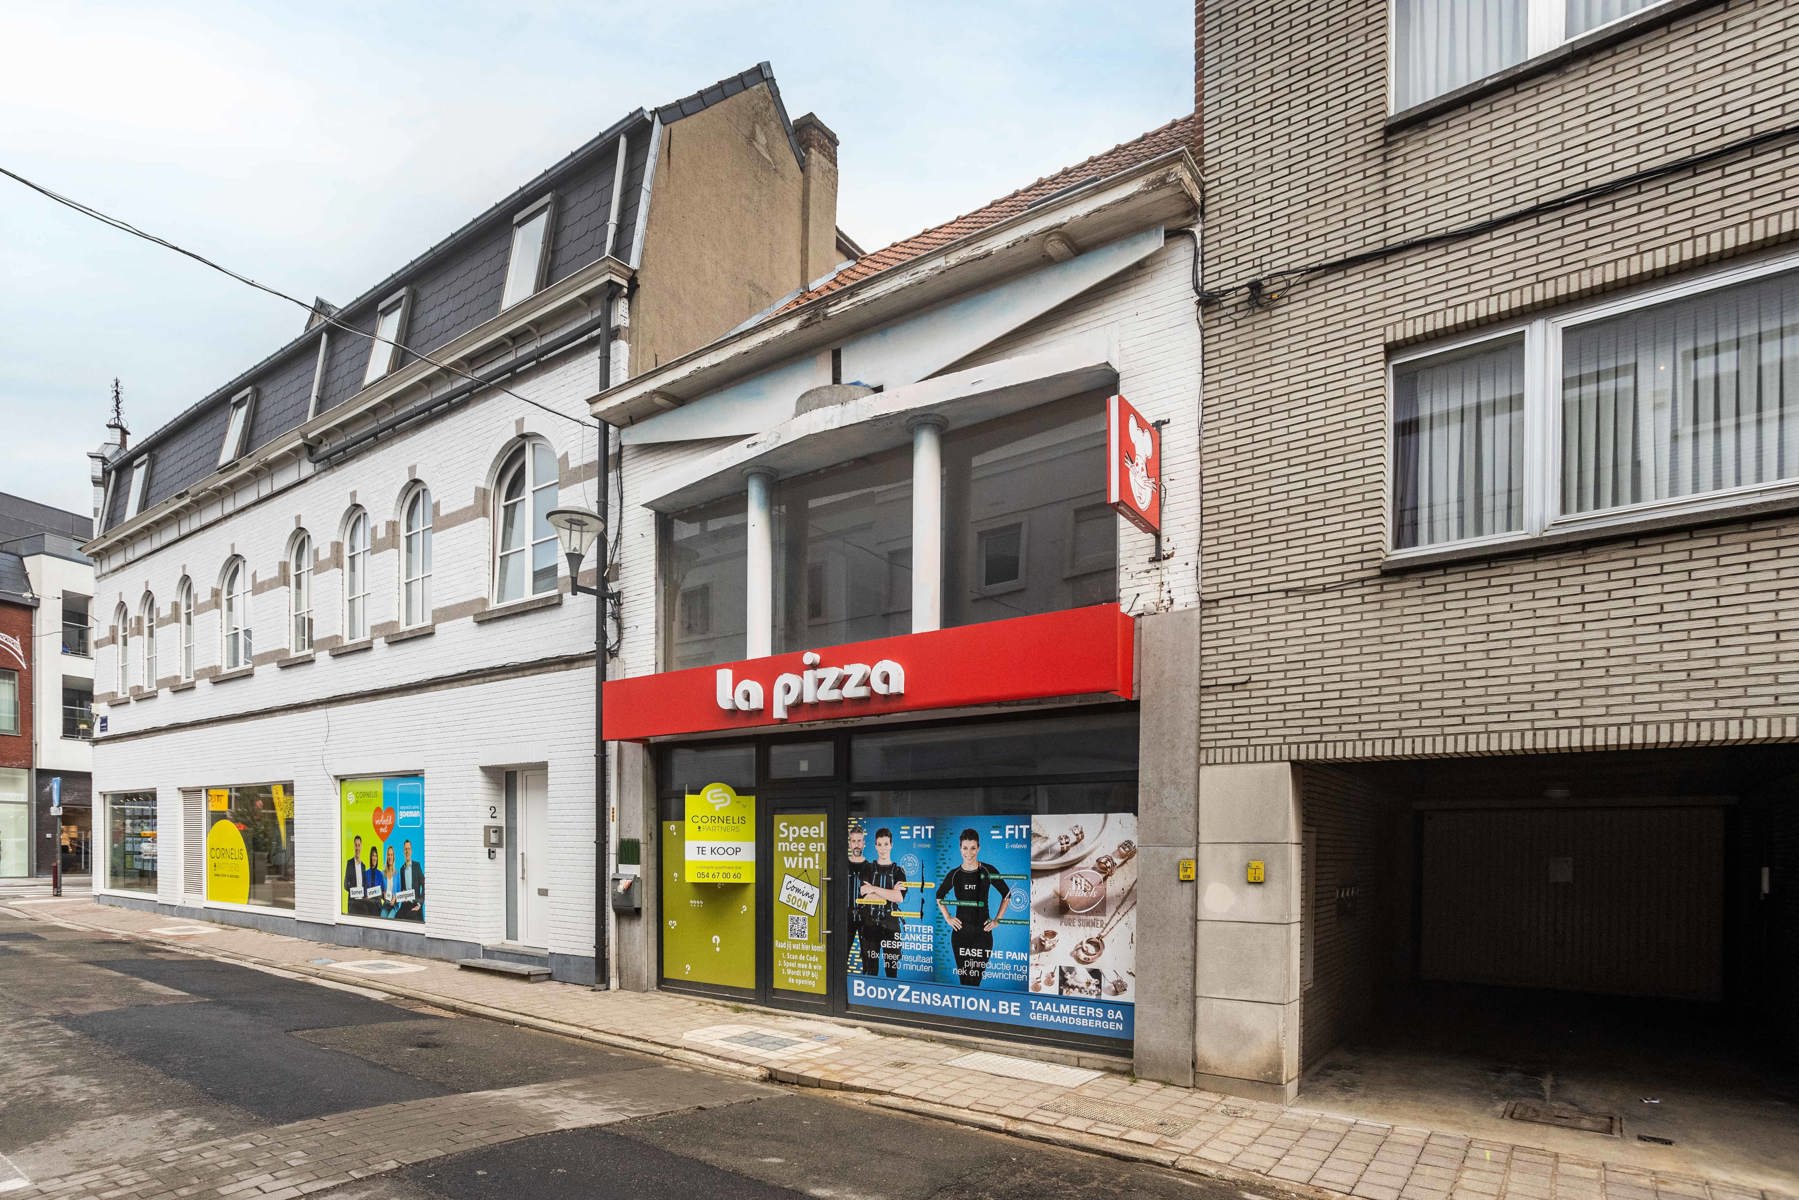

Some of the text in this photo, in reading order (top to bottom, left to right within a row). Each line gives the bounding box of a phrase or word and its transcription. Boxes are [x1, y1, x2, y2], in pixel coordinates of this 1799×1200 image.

[716, 651, 905, 720] la pizza
[489, 805, 497, 819] 2
[691, 815, 746, 825] CORNELIS
[779, 821, 824, 841] Speel
[209, 847, 244, 860] CORNELIS
[696, 846, 741, 856] TE KOOP
[778, 841, 825, 852] mee en
[784, 852, 819, 870] win!
[696, 871, 709, 879] 054
[785, 880, 815, 904] Coming
[785, 893, 808, 911] SOON
[904, 924, 934, 934] FITTER
[1060, 919, 1105, 929] PURE SUMMER
[894, 932, 933, 943] SLANKER
[880, 939, 933, 952] GESPIERDER
[867, 950, 933, 964] 18x meer resultaat
[959, 947, 1028, 961] EASE THE PAIN
[891, 961, 902, 970] 20
[903, 963, 934, 973] minuten
[964, 959, 1028, 974] pijnreductie rug
[952, 967, 1028, 981] nek en gewrichten
[1029, 1000, 1124, 1021] TAALMEERS 8A
[1029, 1012, 1123, 1031] GERAARDSBERGEN
